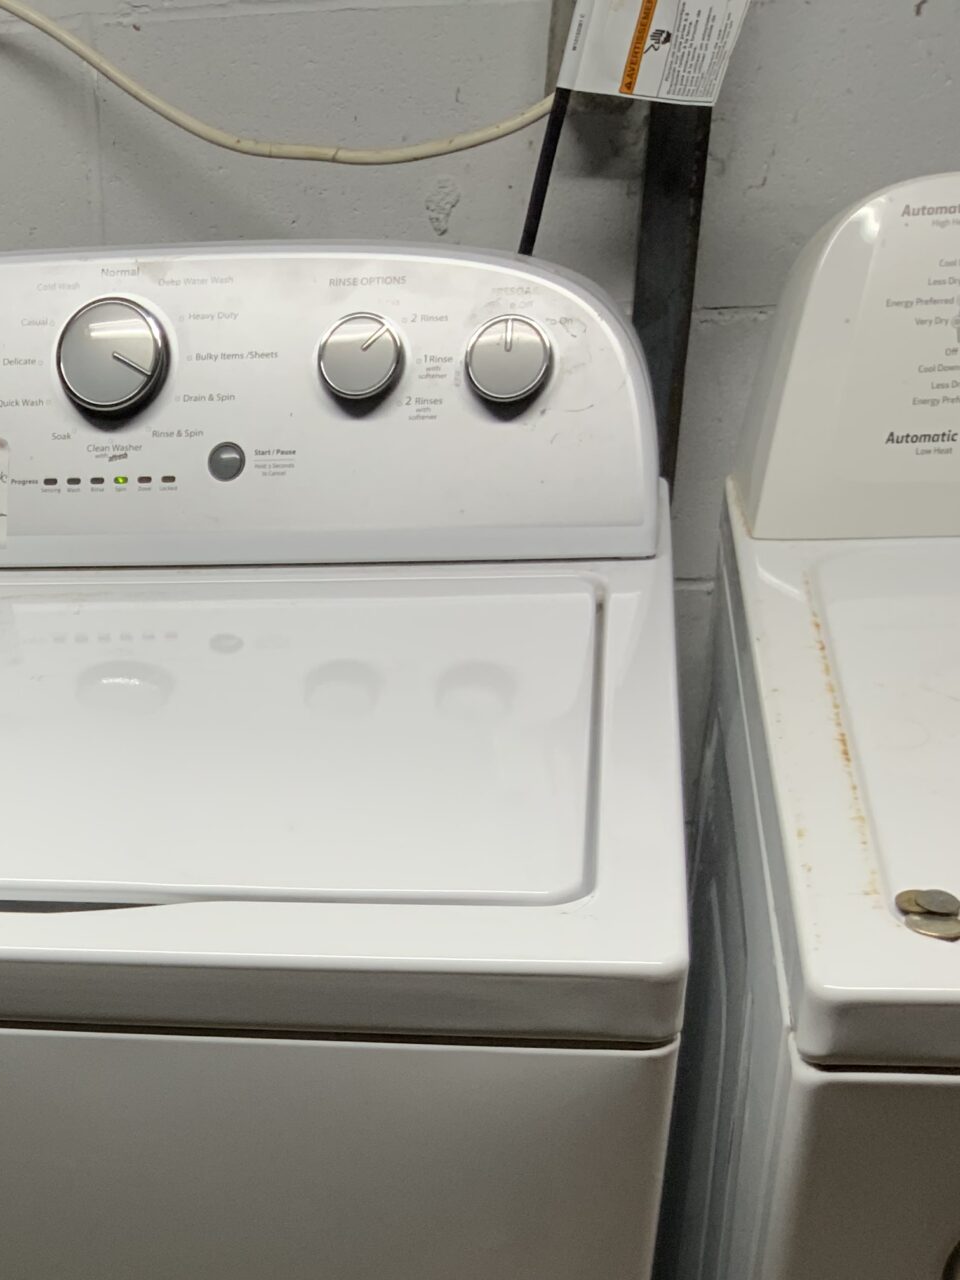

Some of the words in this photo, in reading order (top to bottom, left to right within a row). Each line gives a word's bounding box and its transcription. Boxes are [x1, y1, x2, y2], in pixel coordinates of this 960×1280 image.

[101, 267, 140, 277] Normal
[329, 276, 358, 287] RINSE
[360, 275, 406, 286] OPTIONS
[37, 283, 57, 291] Cold
[58, 281, 80, 290] Wash
[885, 299, 914, 309] Energy
[916, 297, 955, 305] Preferred
[189, 312, 215, 321] Heavy
[217, 311, 239, 320] Duty
[411, 313, 418, 323] 2
[420, 313, 448, 323] Rinses
[21, 318, 49, 326] Casual
[914, 317, 933, 327] Very
[934, 316, 949, 326] Dry
[945, 347, 958, 356] Off
[195, 352, 218, 362] Bulky
[220, 351, 244, 360] Items
[429, 354, 453, 363] Rinse
[3, 358, 37, 366] Delicate
[918, 365, 936, 373] Cool
[931, 382, 949, 390] Less
[183, 393, 206, 402] Drain
[208, 393, 214, 401] &
[216, 393, 236, 403] Spin
[405, 397, 412, 406] 2
[415, 397, 443, 406] Rinses
[912, 397, 940, 407] Energy
[22, 399, 44, 407] Wash
[51, 432, 71, 440] Soak
[152, 430, 174, 439] Rinse
[184, 430, 204, 439] Spin
[885, 429, 958, 445] Automatic
[86, 444, 110, 453] Clean
[112, 444, 142, 452] Washer
[254, 448, 271, 456] Start
[276, 448, 296, 456] Pause
[915, 447, 932, 455] Low
[933, 446, 952, 454] Heat
[10, 478, 38, 486] Progress
